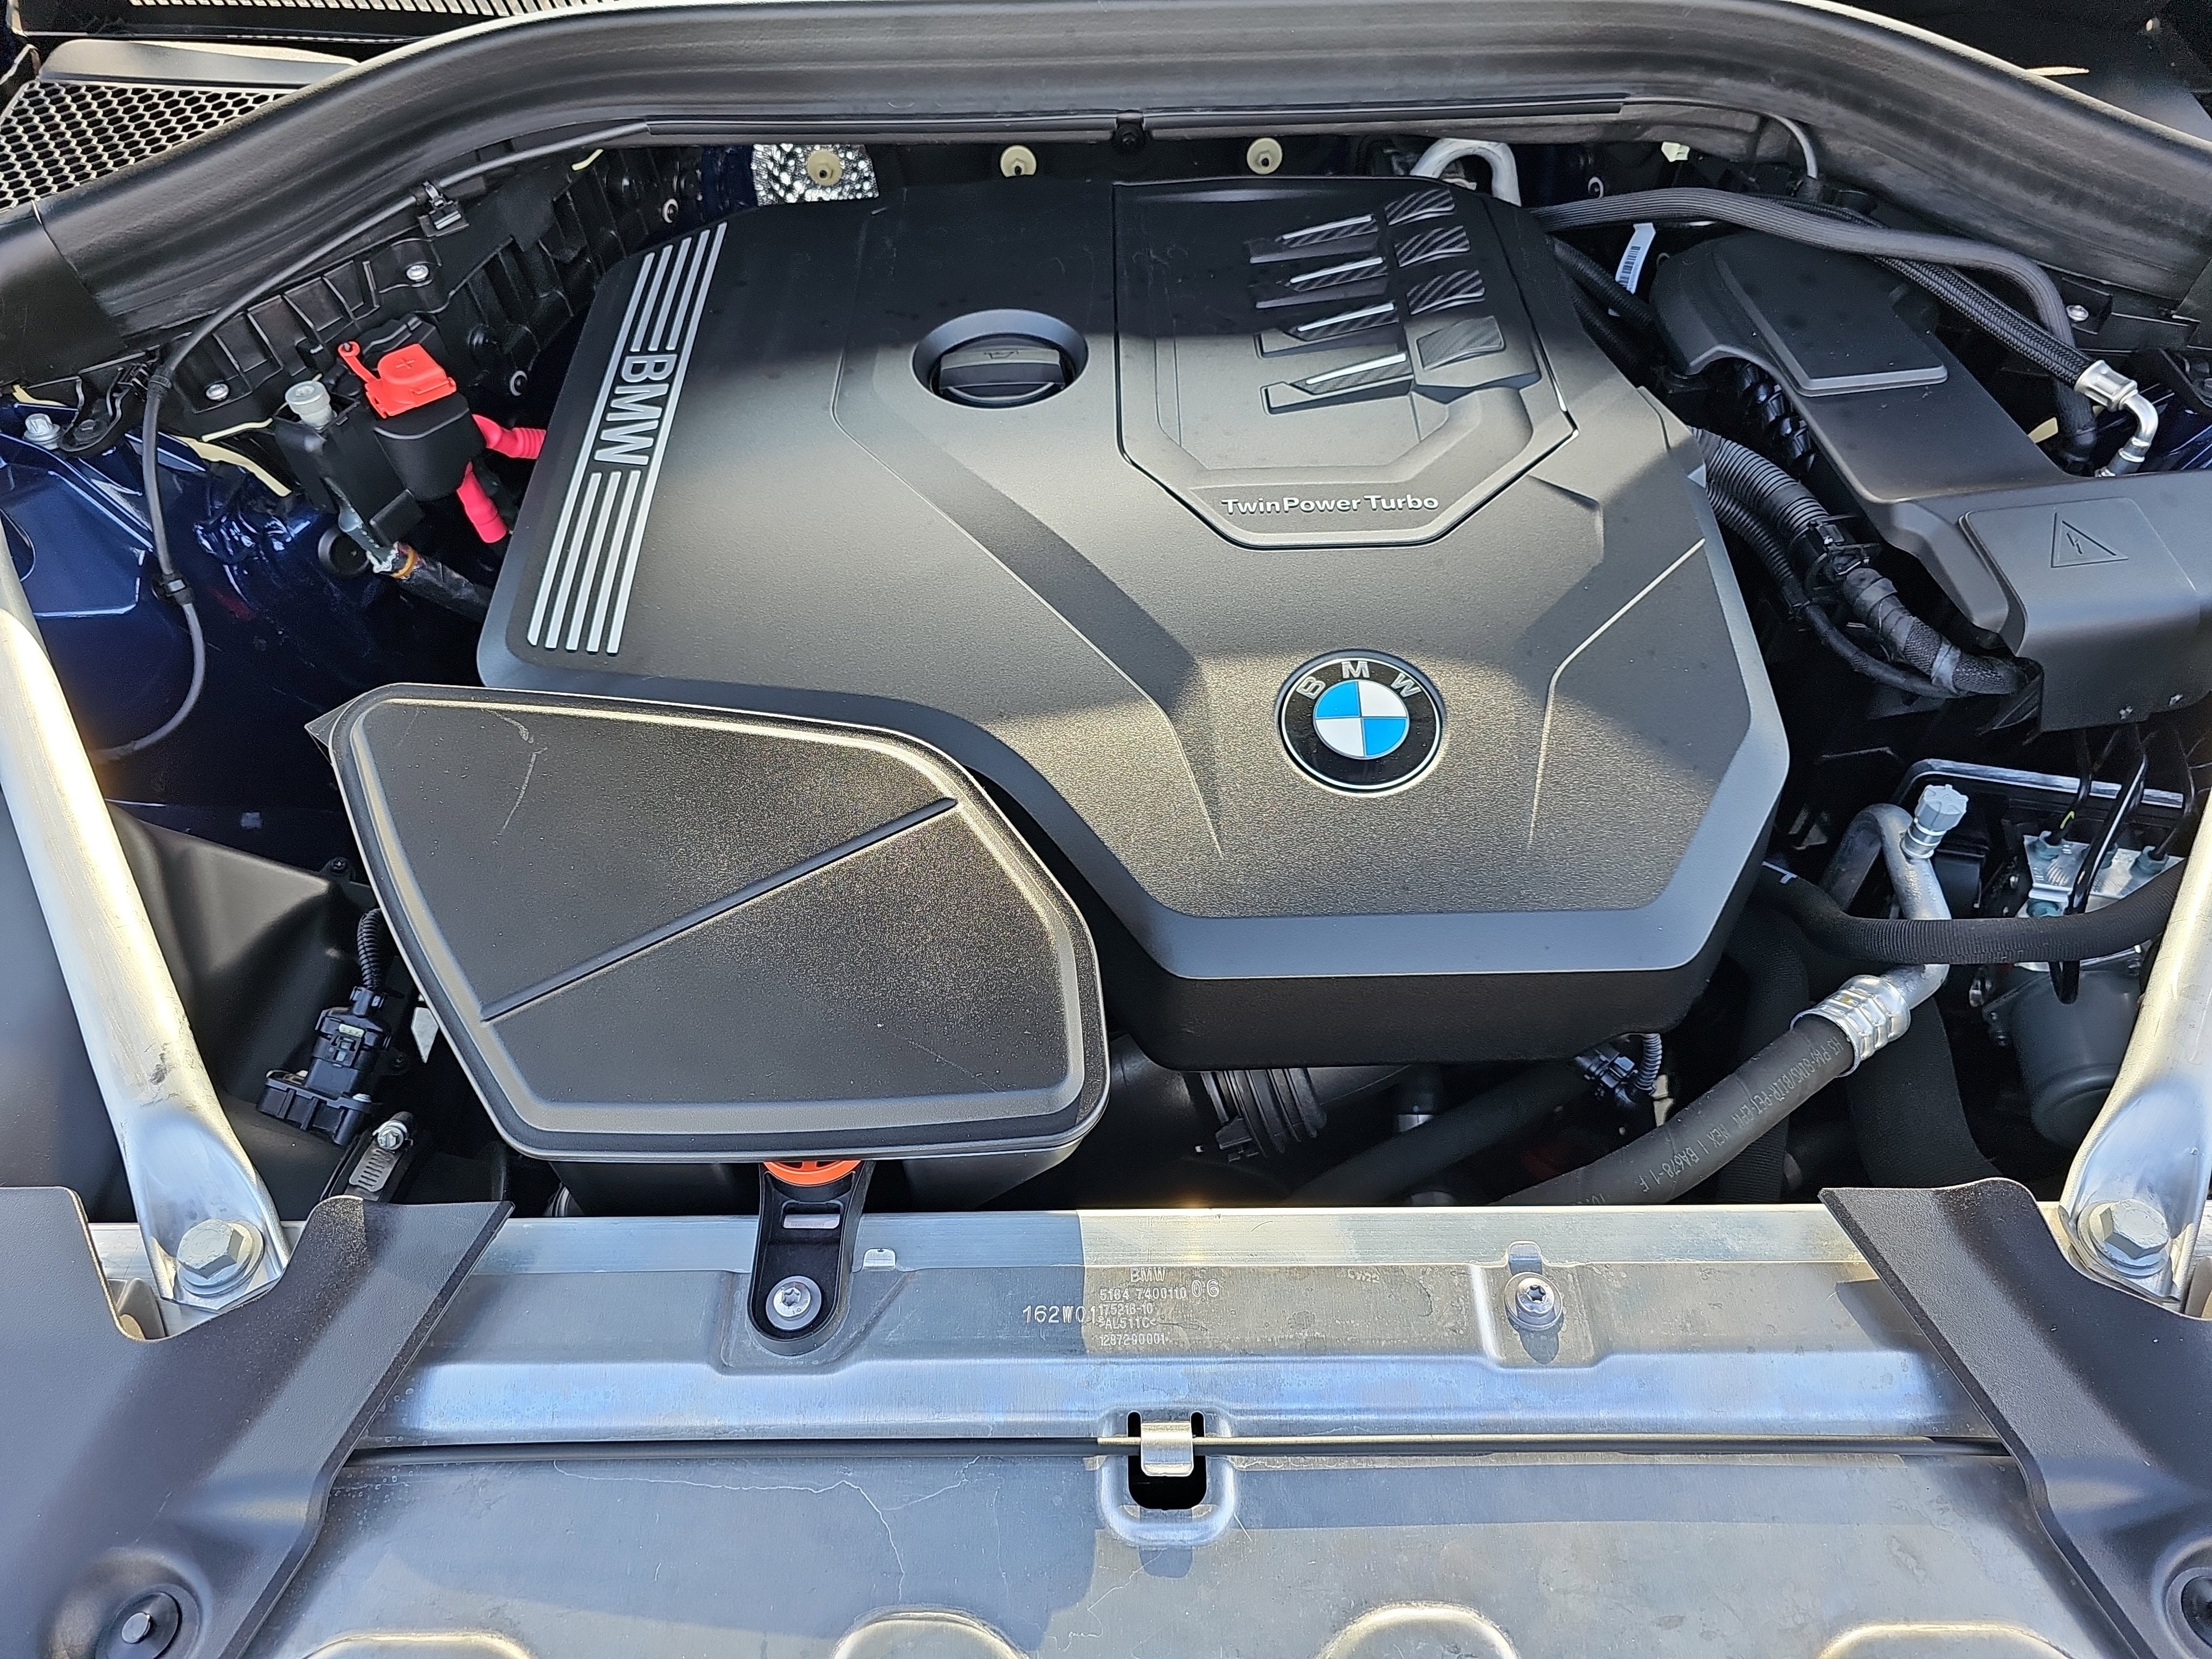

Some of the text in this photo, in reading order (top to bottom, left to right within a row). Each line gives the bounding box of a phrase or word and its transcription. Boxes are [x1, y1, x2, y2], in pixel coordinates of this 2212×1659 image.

[594, 354, 678, 466] BMW
[1221, 494, 1439, 515] TwinPower Turbo
[1296, 661, 1422, 700] BMW
[1130, 1266, 1166, 1282] BMW
[1191, 1279, 1220, 1297] 06
[1023, 1304, 1096, 1324] 162W01
